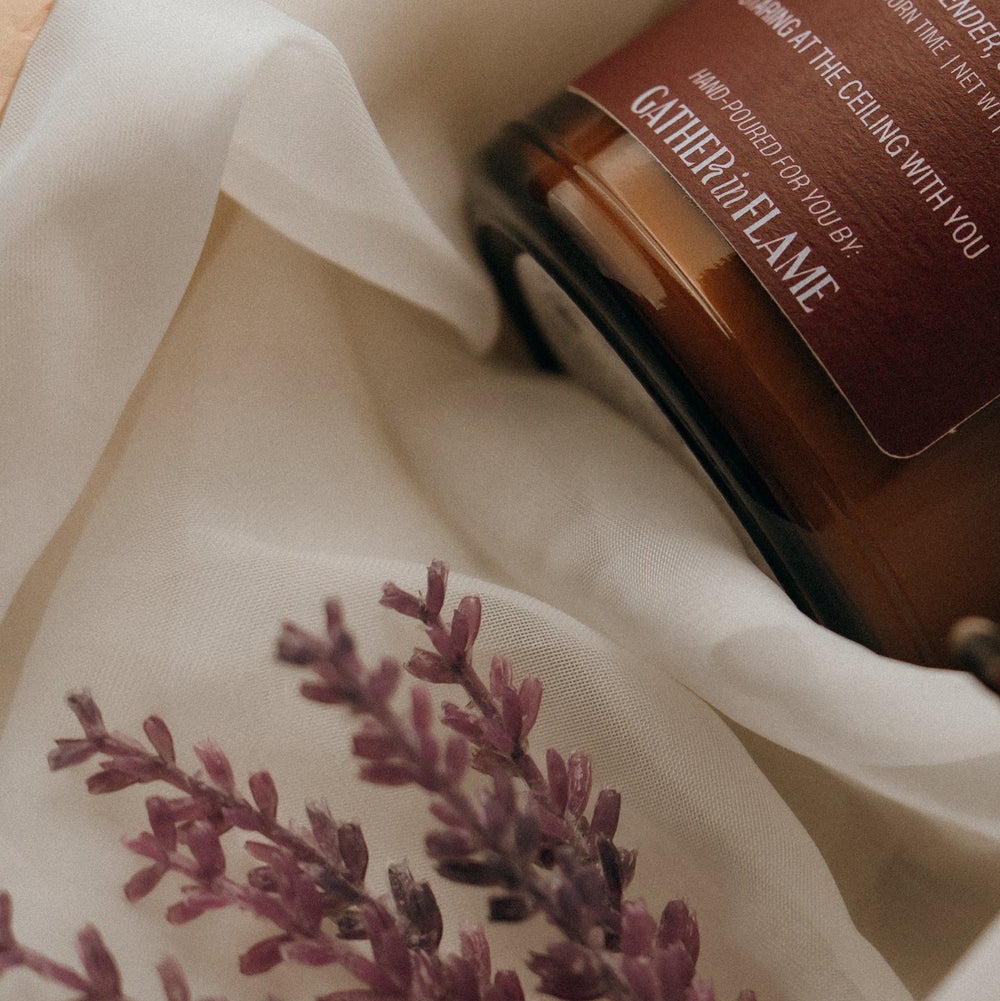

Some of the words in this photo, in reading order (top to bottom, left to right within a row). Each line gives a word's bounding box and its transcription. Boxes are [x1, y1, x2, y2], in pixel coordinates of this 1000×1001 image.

[787, 29, 823, 54] AT
[808, 46, 852, 87] THE
[837, 79, 910, 158] CEILING
[900, 149, 954, 212] WITH
[943, 204, 990, 260] YOU
[913, 17, 952, 57] TIME
[950, 61, 986, 94] NET
[630, 85, 735, 186] GATHER
[730, 191, 840, 313] FLAME
[688, 68, 783, 157] HAND-POURED
[770, 154, 811, 191] FOR
[800, 187, 842, 227] YOU
[828, 225, 865, 258] BY:
